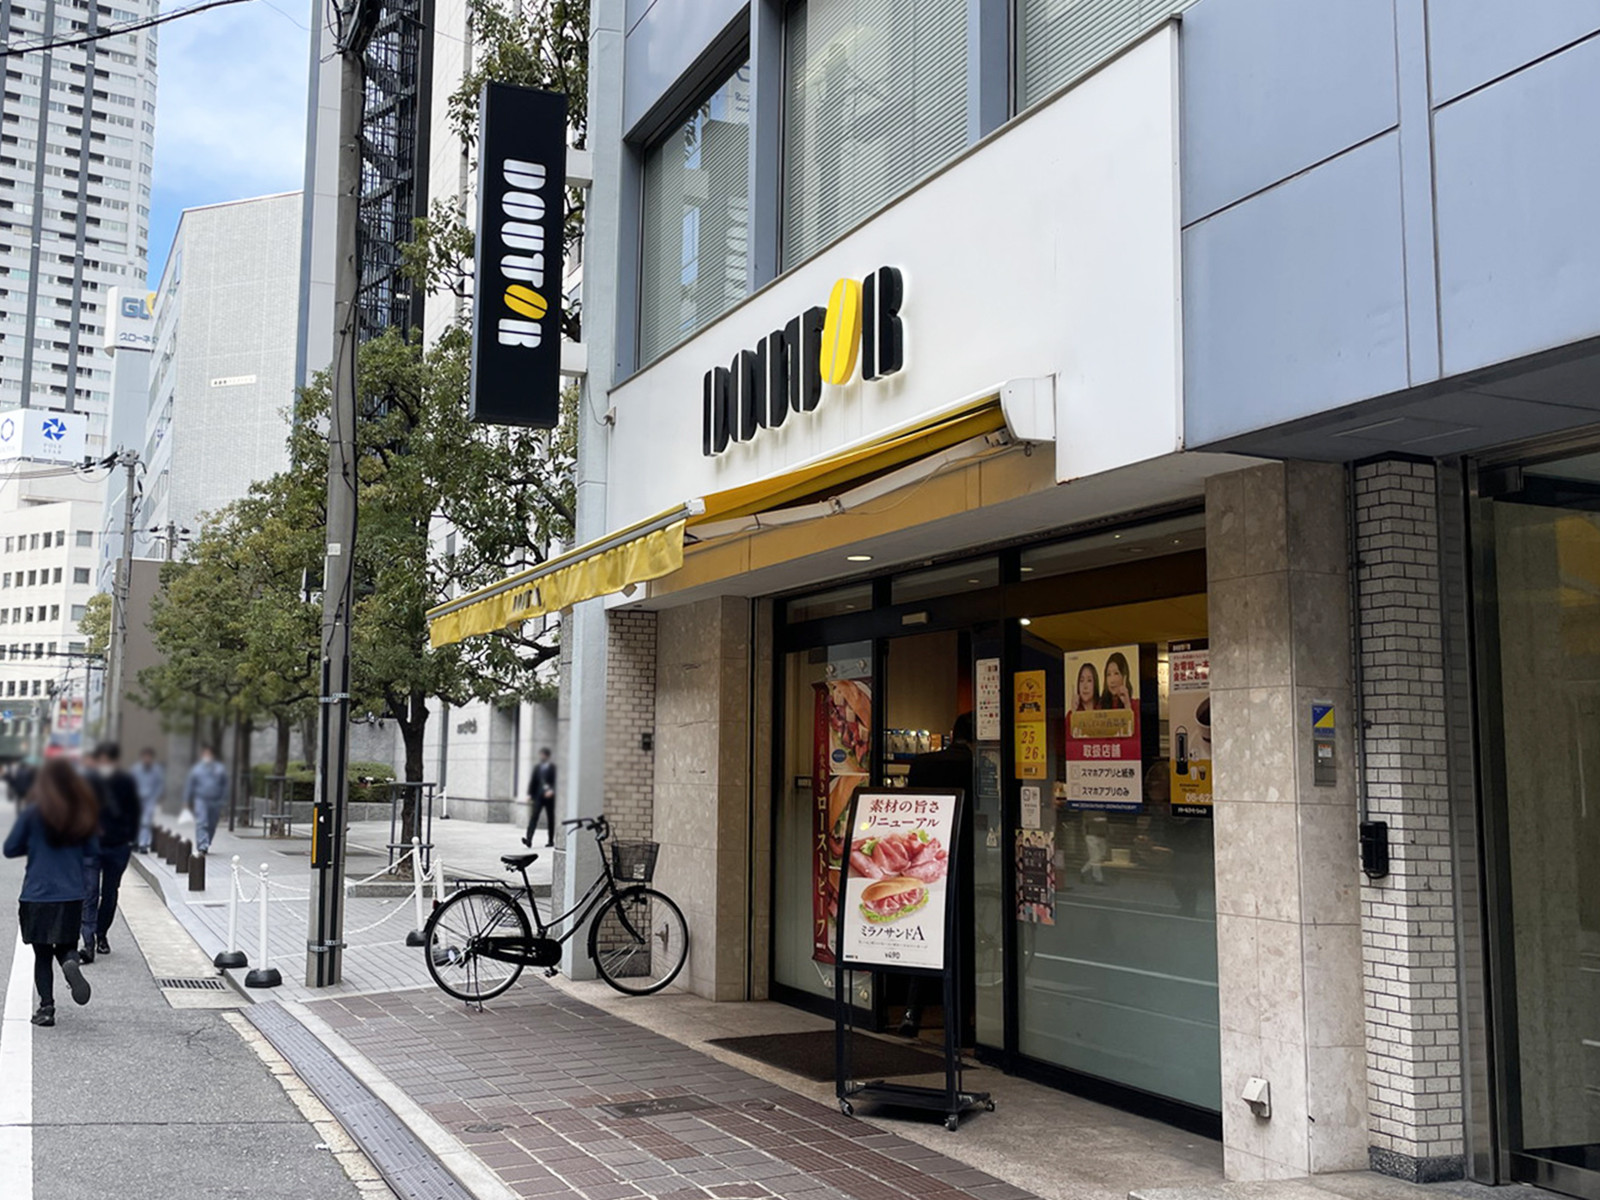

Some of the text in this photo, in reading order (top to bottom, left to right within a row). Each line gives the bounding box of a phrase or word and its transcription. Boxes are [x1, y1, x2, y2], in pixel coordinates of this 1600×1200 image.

[498, 158, 549, 348] DOUTOR
[703, 265, 904, 457] DOUTOR
[1021, 730, 1035, 744] 25
[1024, 746, 1040, 760] 26
[1083, 743, 1121, 758] 取扱店舗
[1081, 768, 1135, 779] スマホアプリと紙券
[1081, 786, 1130, 797] スマホアプリのみ
[869, 798, 940, 814] 素材の旨さ
[868, 815, 940, 829] リニューアル
[860, 925, 926, 942] ミラノサンドA
